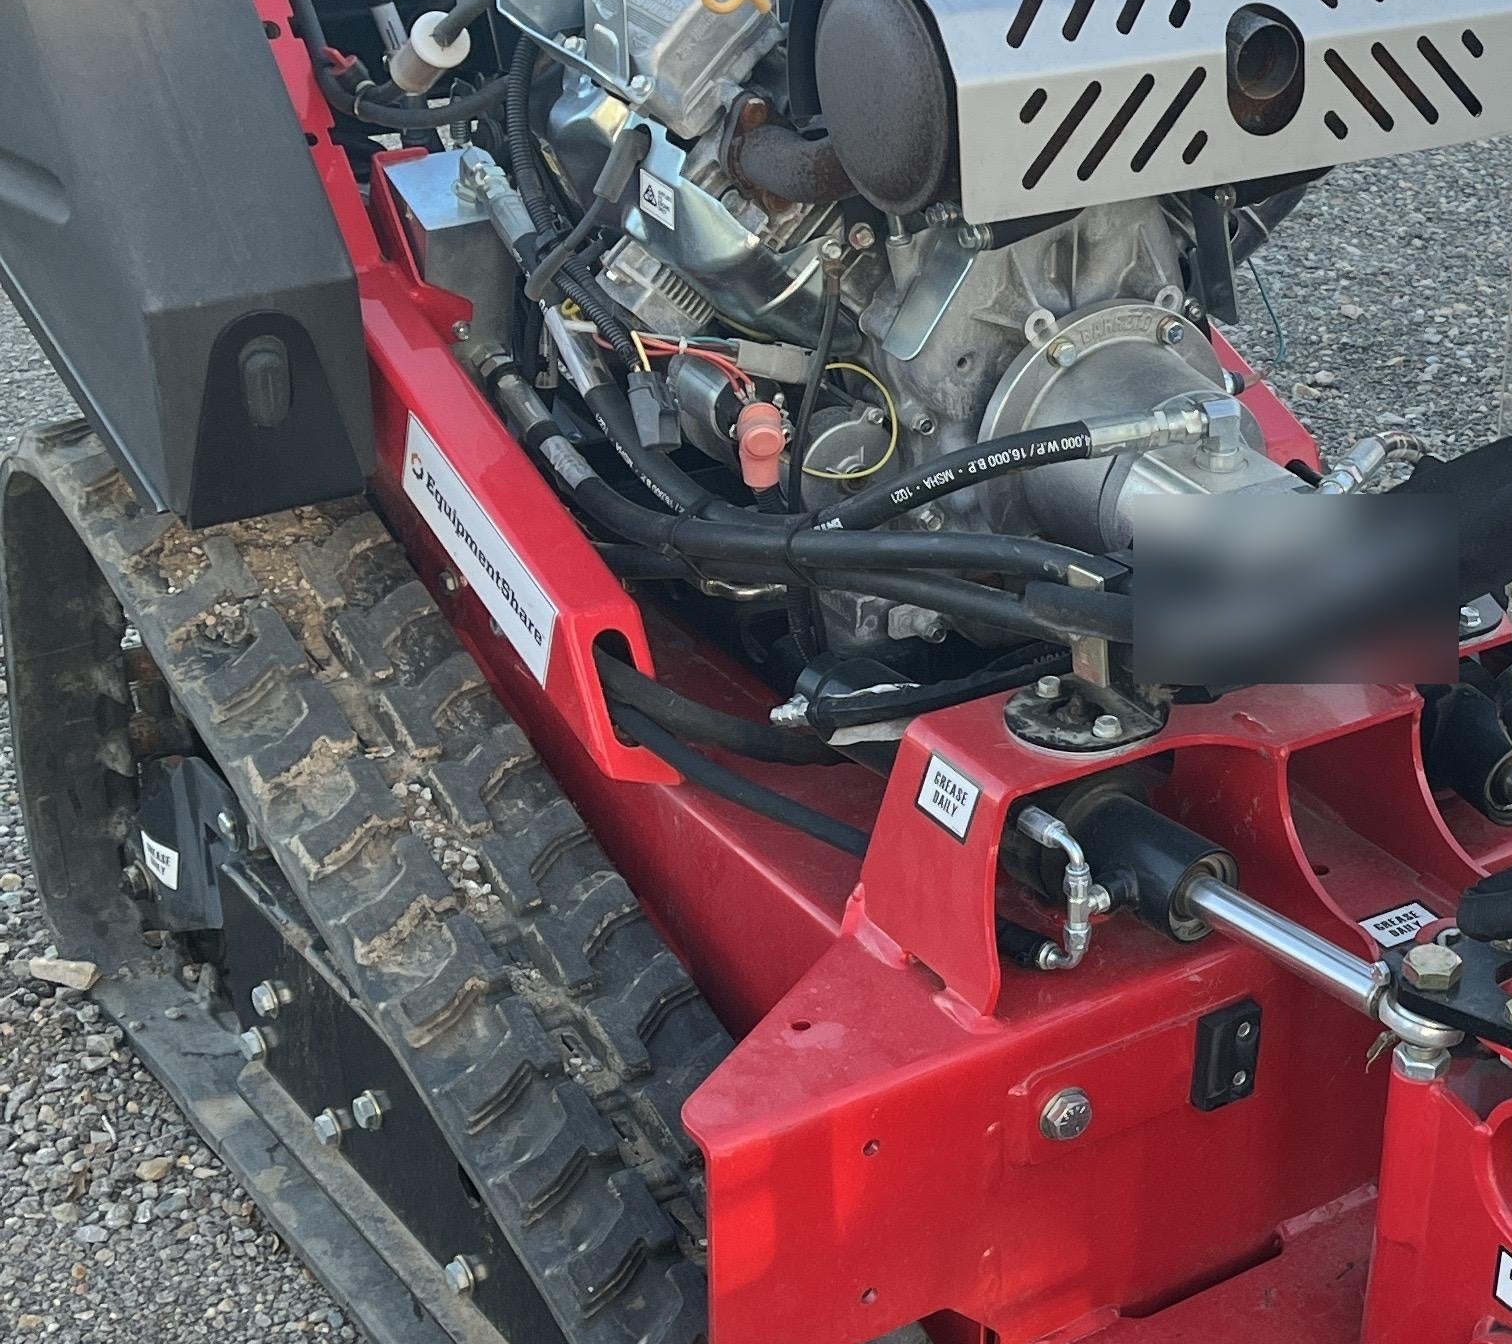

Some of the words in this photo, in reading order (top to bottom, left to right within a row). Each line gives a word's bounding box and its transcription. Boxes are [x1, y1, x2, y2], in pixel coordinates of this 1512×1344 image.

[923, 468, 955, 490] MSHA
[425, 471, 543, 647] EquipmentShare
[933, 770, 969, 807] GREASE
[932, 789, 959, 817] DAILY
[1372, 910, 1421, 931] GREASE
[1387, 919, 1425, 939] DAILY
